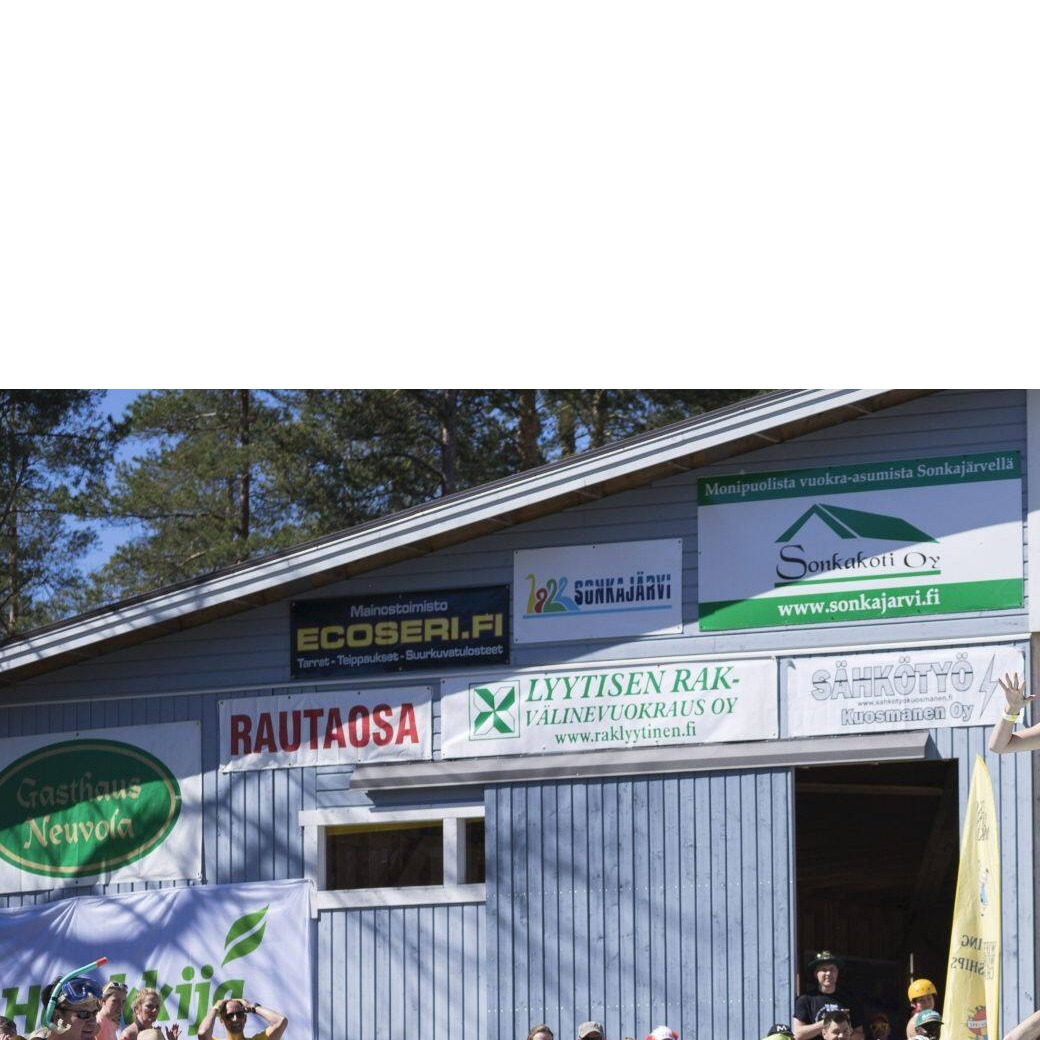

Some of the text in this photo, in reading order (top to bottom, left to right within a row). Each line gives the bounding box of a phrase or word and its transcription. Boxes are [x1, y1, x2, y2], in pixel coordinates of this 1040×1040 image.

[705, 457, 1014, 496] Monipuolista vuokra-asumista Sonkajärvellä
[776, 545, 941, 580] Sonkakoti Oy
[574, 571, 671, 605] SONKAJÄRVI
[778, 588, 941, 616] www.sonkajarvi.fi
[350, 600, 449, 618] Mainostoimisto
[297, 613, 503, 652] ECOSERI.FI
[298, 657, 330, 669] Tarrat
[337, 652, 399, 667] Teippaukset
[406, 644, 503, 661] Suurkuvatulosteet
[525, 666, 740, 702] LYYTISEN RAK-
[811, 651, 974, 701] SÄHKÖTYÖ
[230, 703, 420, 756] RAUTAOSA
[526, 697, 739, 727] VÄLINEVUOKRAUS OY
[841, 701, 974, 726] Kuosmanen Oy
[555, 721, 697, 744] www.raklyytinen.fi
[16, 771, 142, 809] Gasthaus
[24, 807, 135, 849] Neuvola
